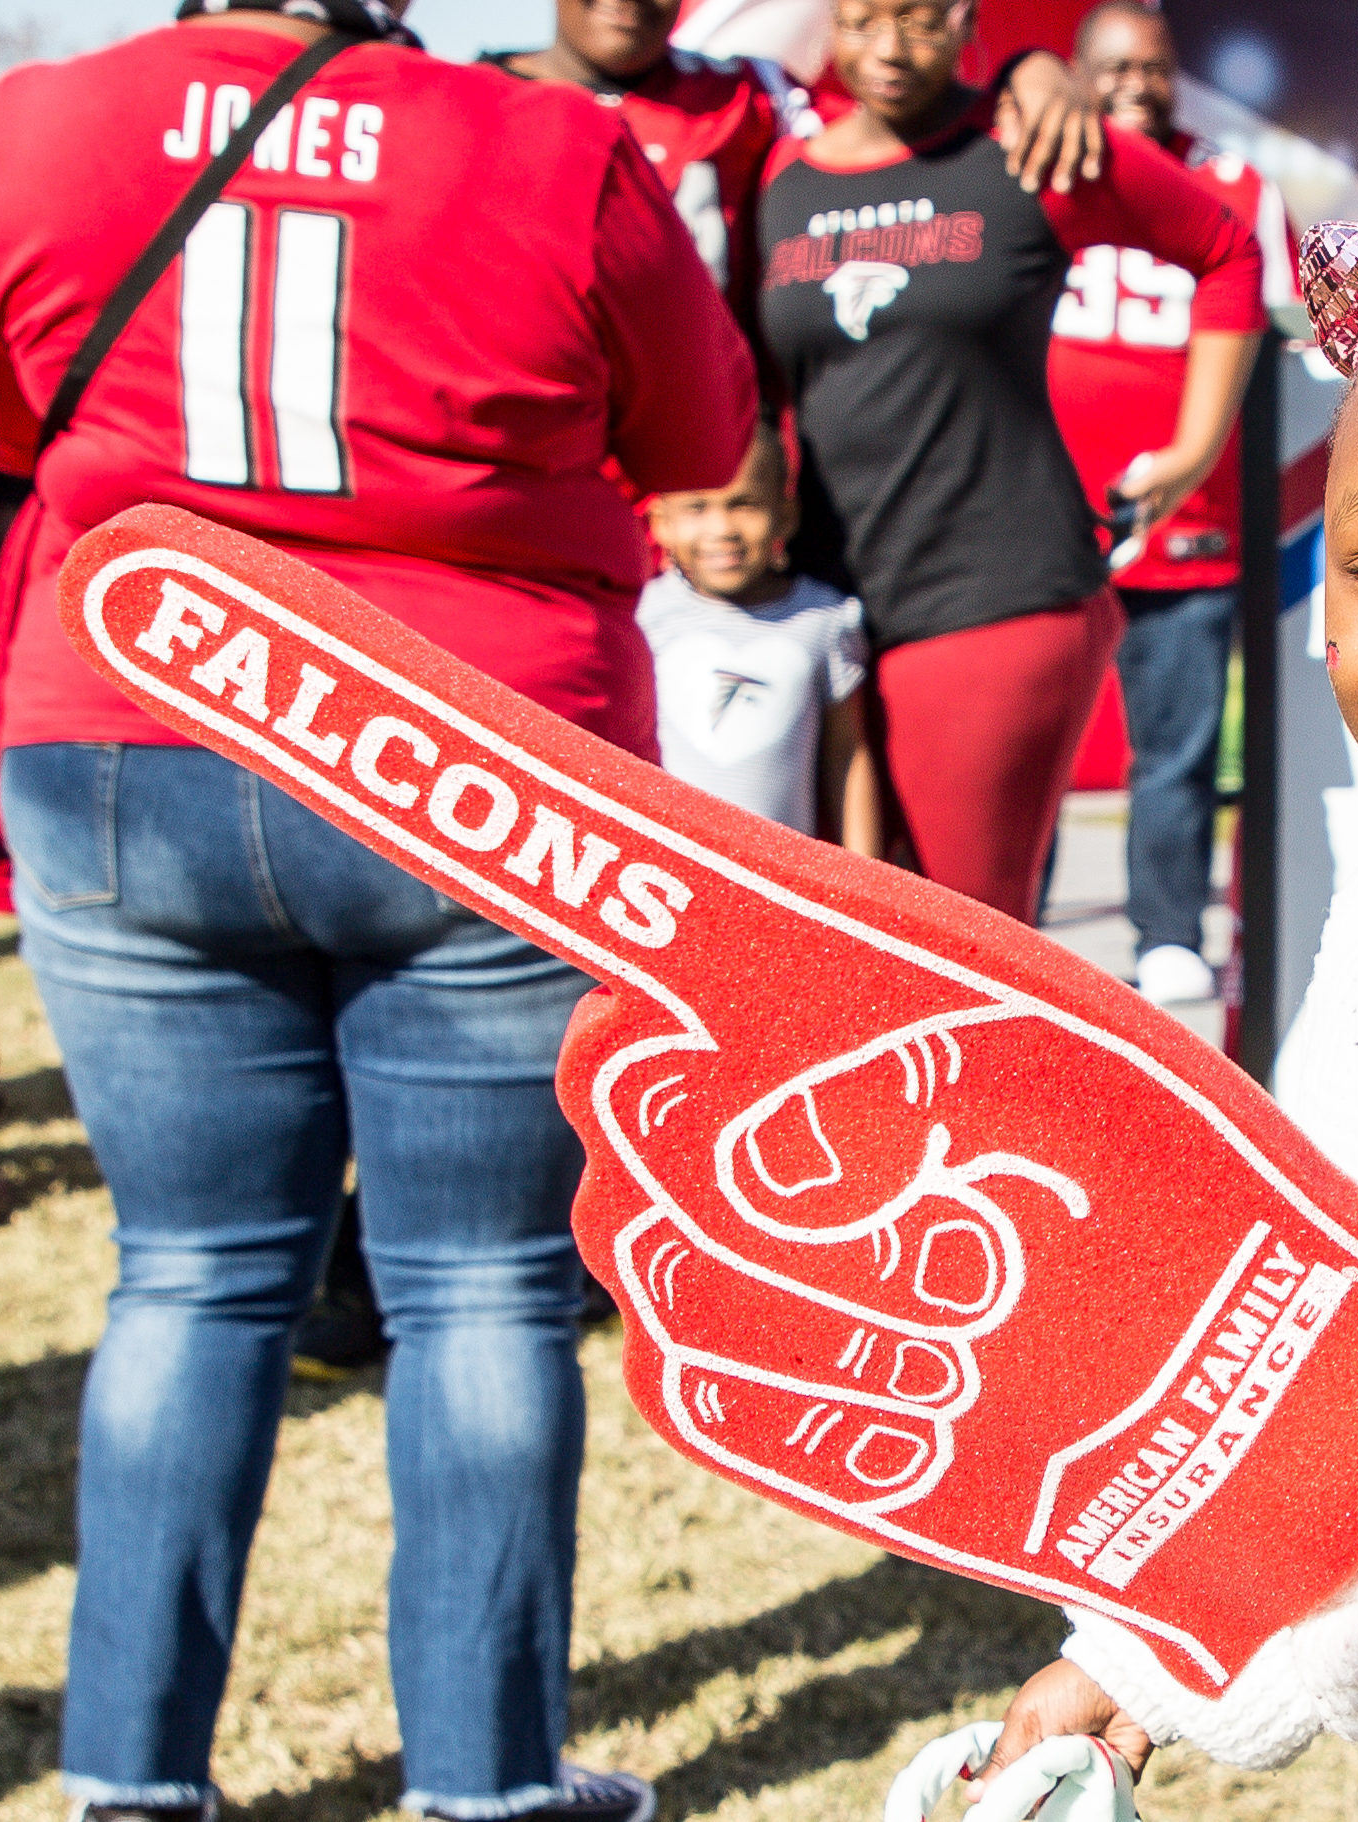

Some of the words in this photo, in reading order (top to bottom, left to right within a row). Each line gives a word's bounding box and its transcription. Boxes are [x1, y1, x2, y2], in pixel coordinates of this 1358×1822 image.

[180, 200, 355, 498] 11
[135, 577, 695, 949] FALCONS
[1056, 1417, 1197, 1570] AMERICAN
[1181, 1241, 1306, 1415] FAMILY
[1114, 1300, 1322, 1561] INSURANCE
